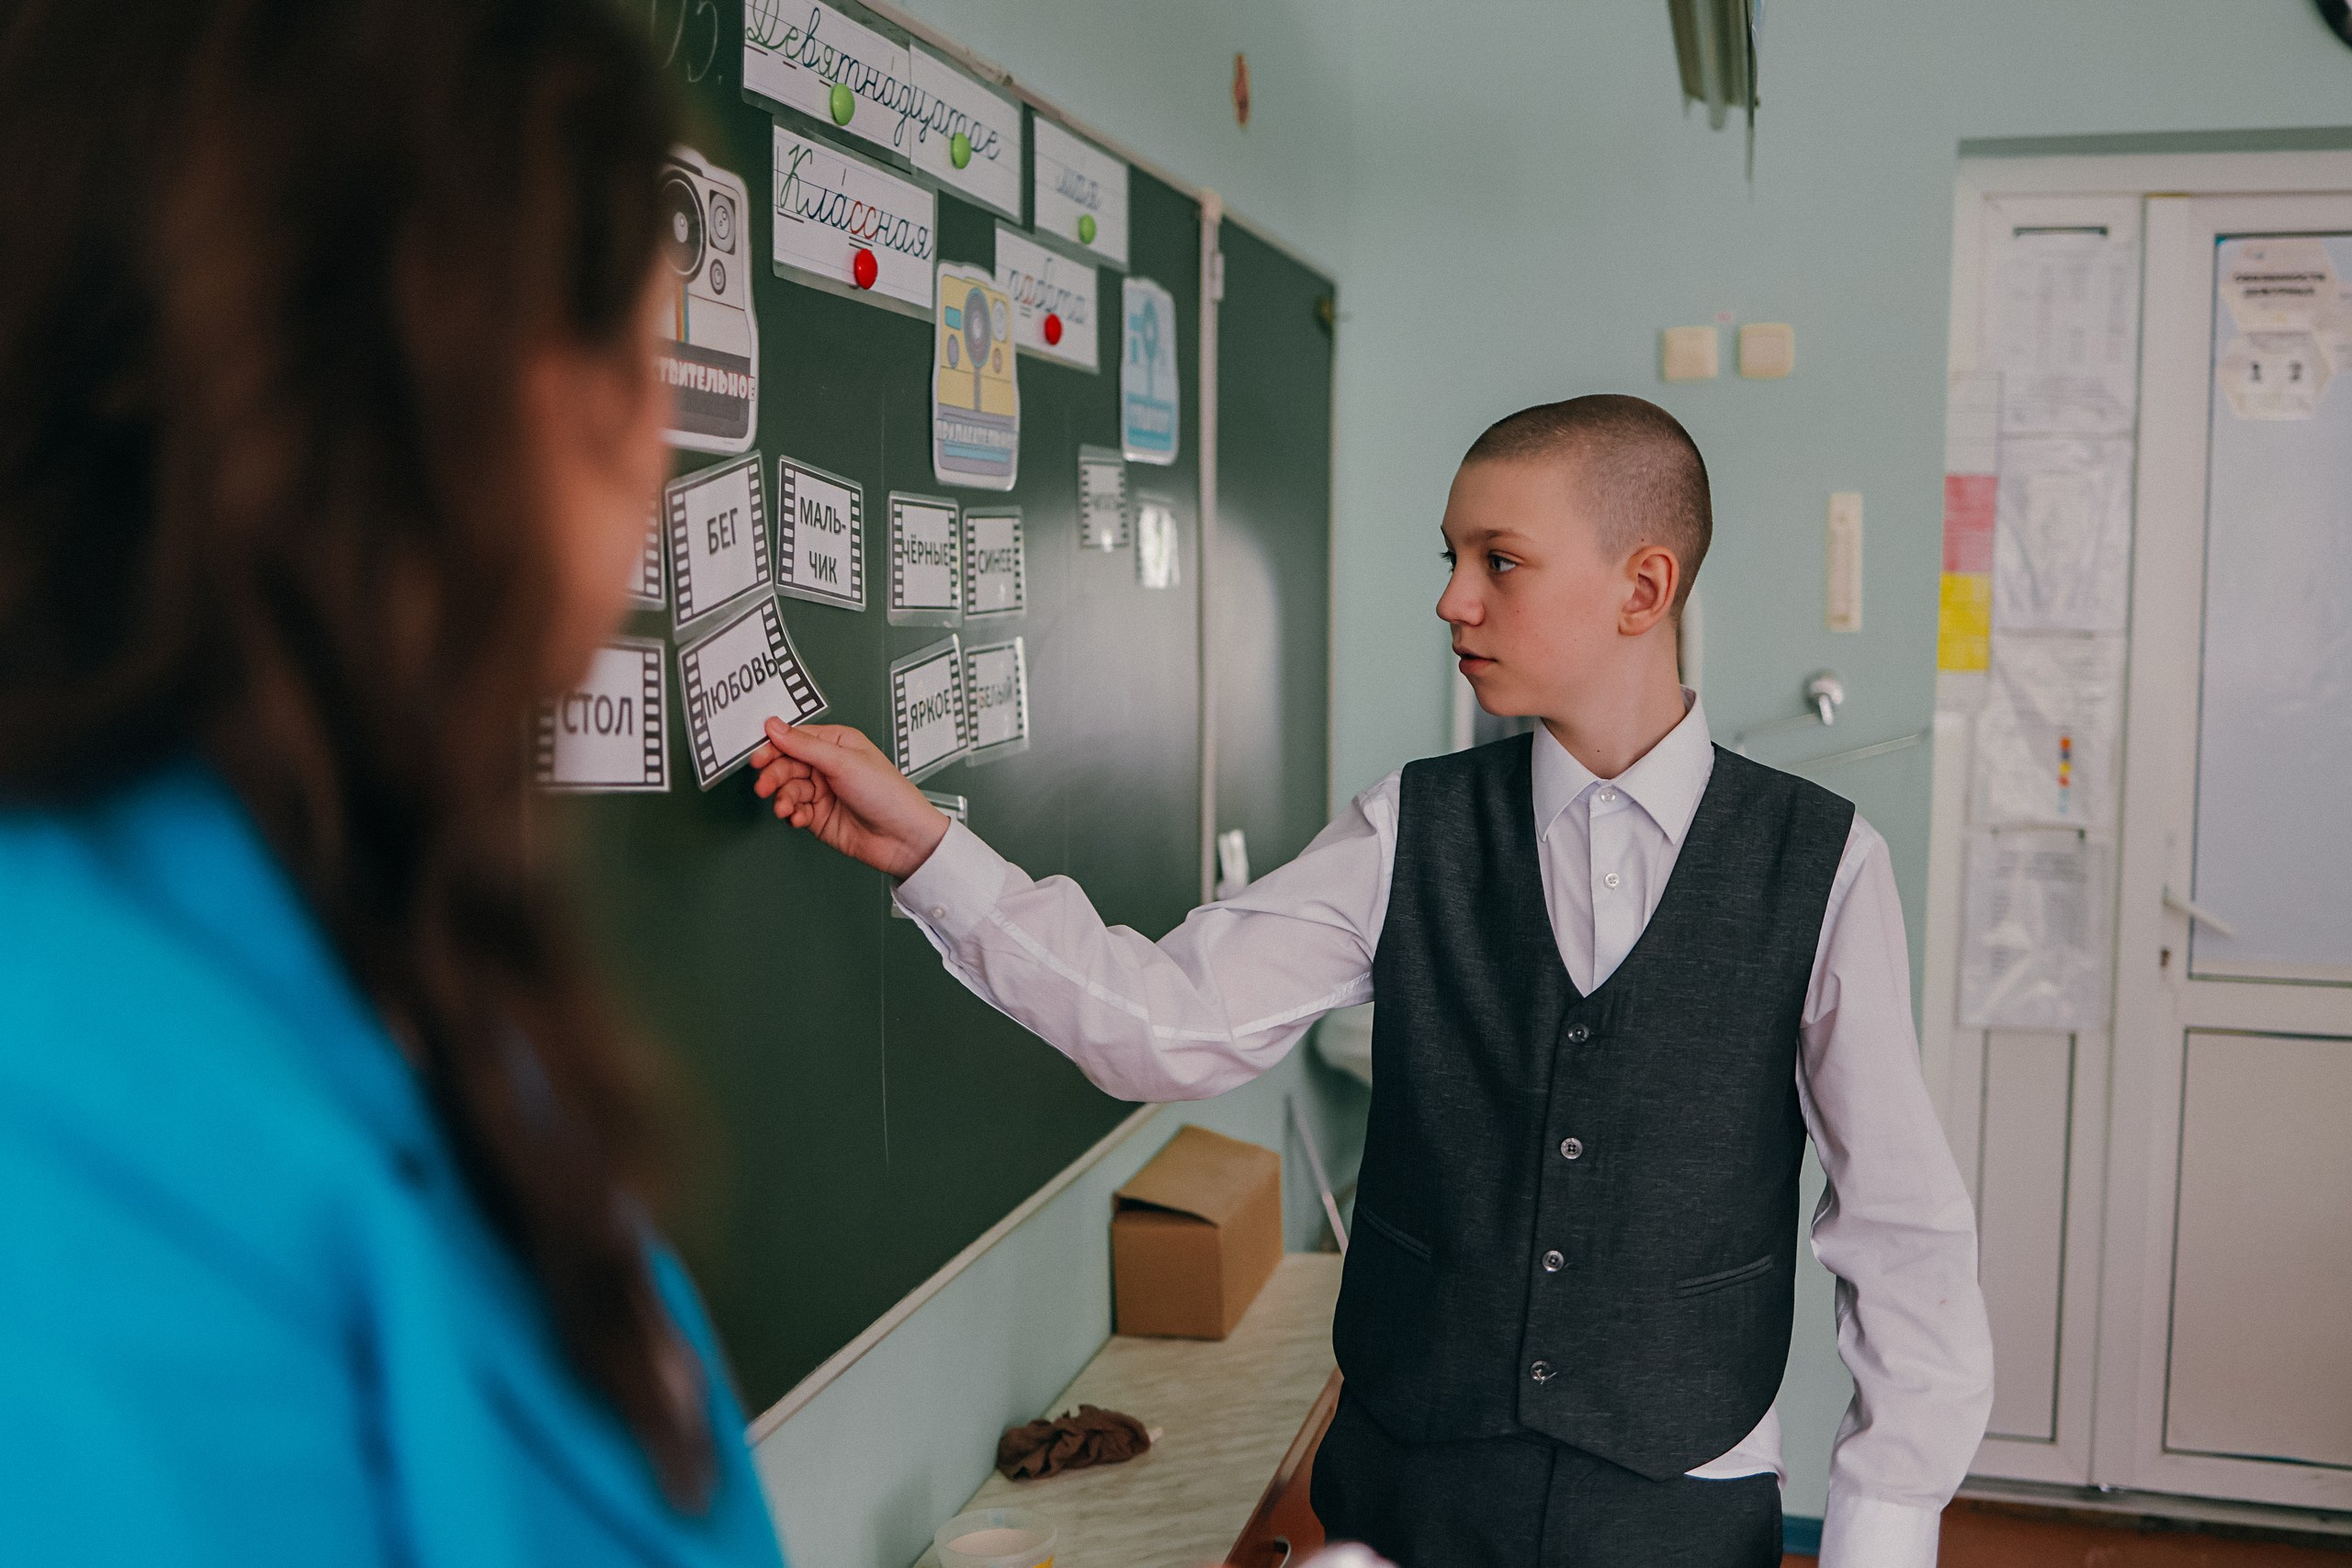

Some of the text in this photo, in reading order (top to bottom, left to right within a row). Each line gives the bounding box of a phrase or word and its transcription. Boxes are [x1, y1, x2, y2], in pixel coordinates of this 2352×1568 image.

[745, 0, 1001, 161] Девятнадцатое
[779, 144, 933, 260] Классная
[655, 355, 756, 400] ТВИТЕЛЬНОЕ
[707, 507, 738, 555] БЕГ
[799, 496, 846, 535] МАЛЬ-
[808, 550, 838, 584] ЧИК
[897, 530, 949, 567] ЧЁРНЫЕ
[699, 651, 778, 725] ЛЮБОВЬ
[910, 689, 952, 731] ЯРКОЕ
[562, 692, 634, 735] СТОЛ
